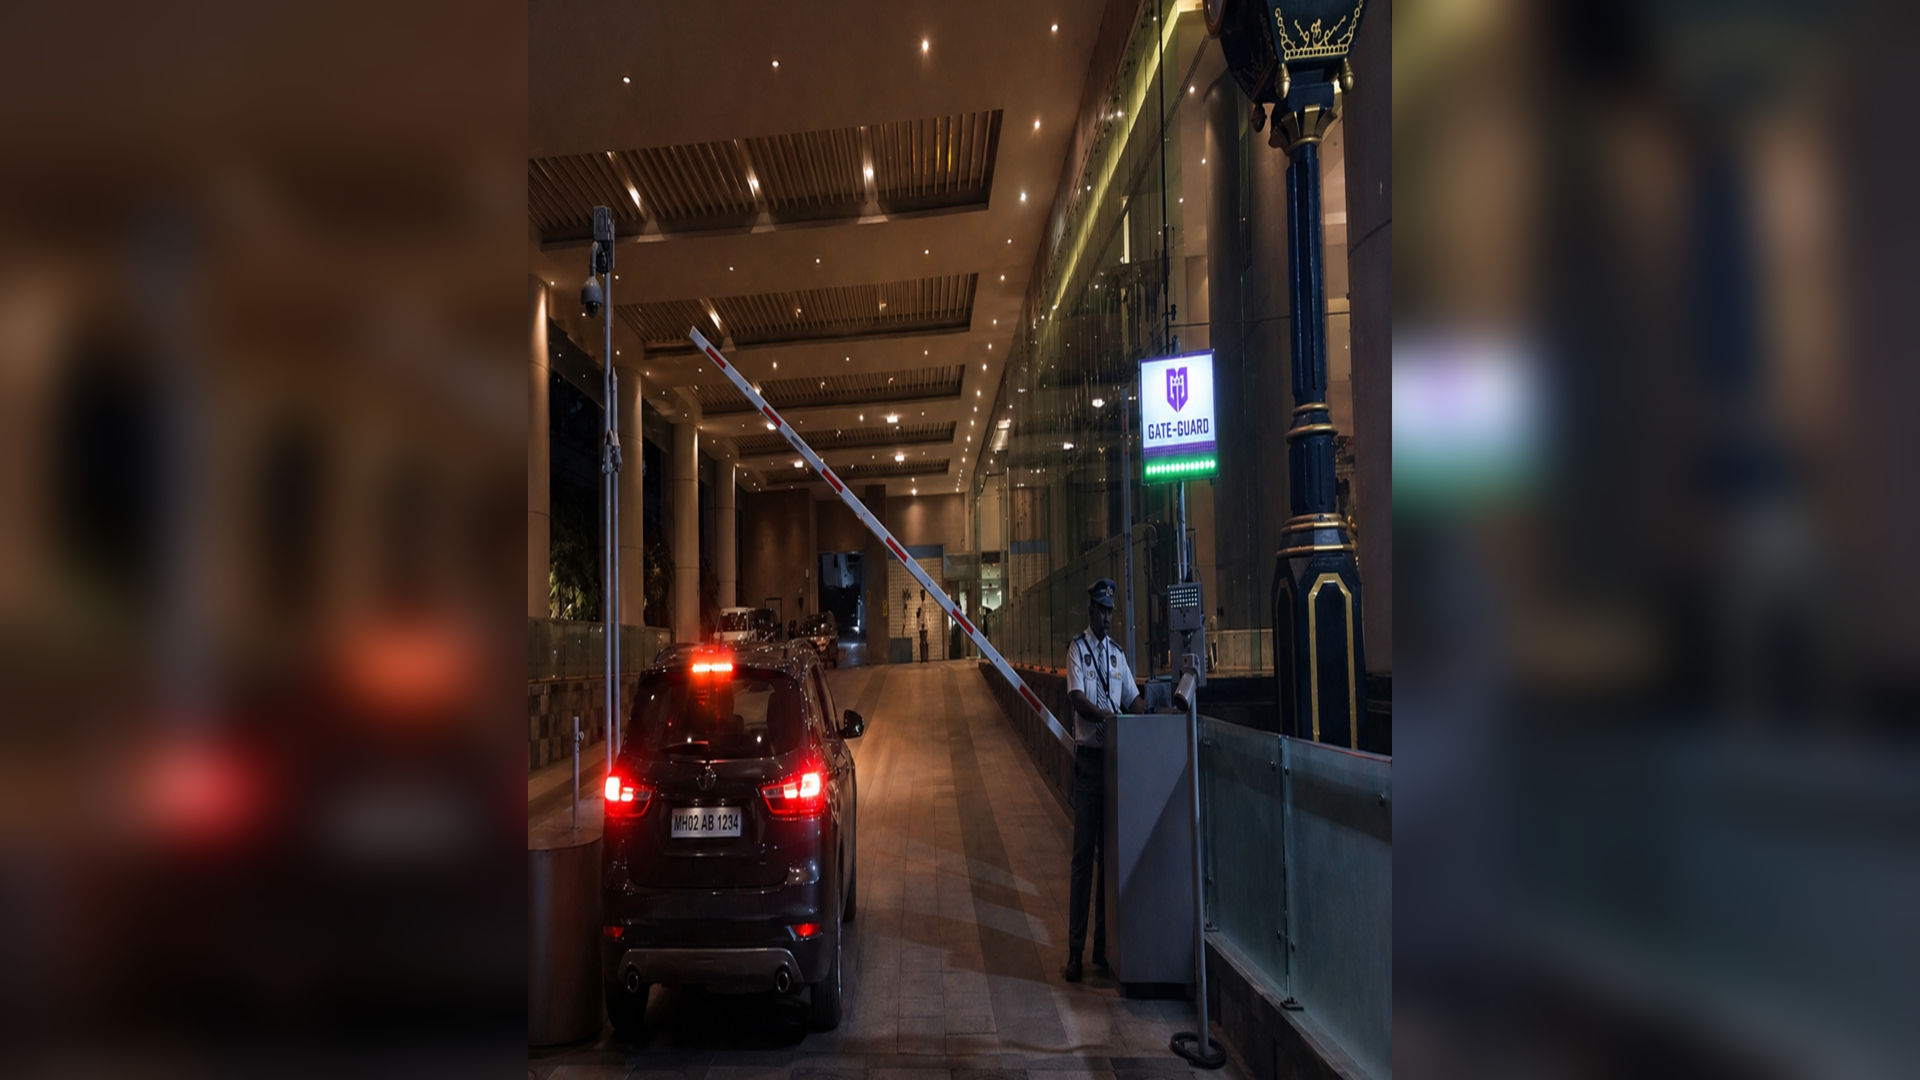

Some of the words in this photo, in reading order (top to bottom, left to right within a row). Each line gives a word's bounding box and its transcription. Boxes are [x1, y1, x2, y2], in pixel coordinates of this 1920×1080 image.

[1148, 418, 1209, 440] GATE-GUARD
[674, 814, 699, 831] MH02
[701, 814, 714, 831] AB
[717, 814, 739, 831] 1234
